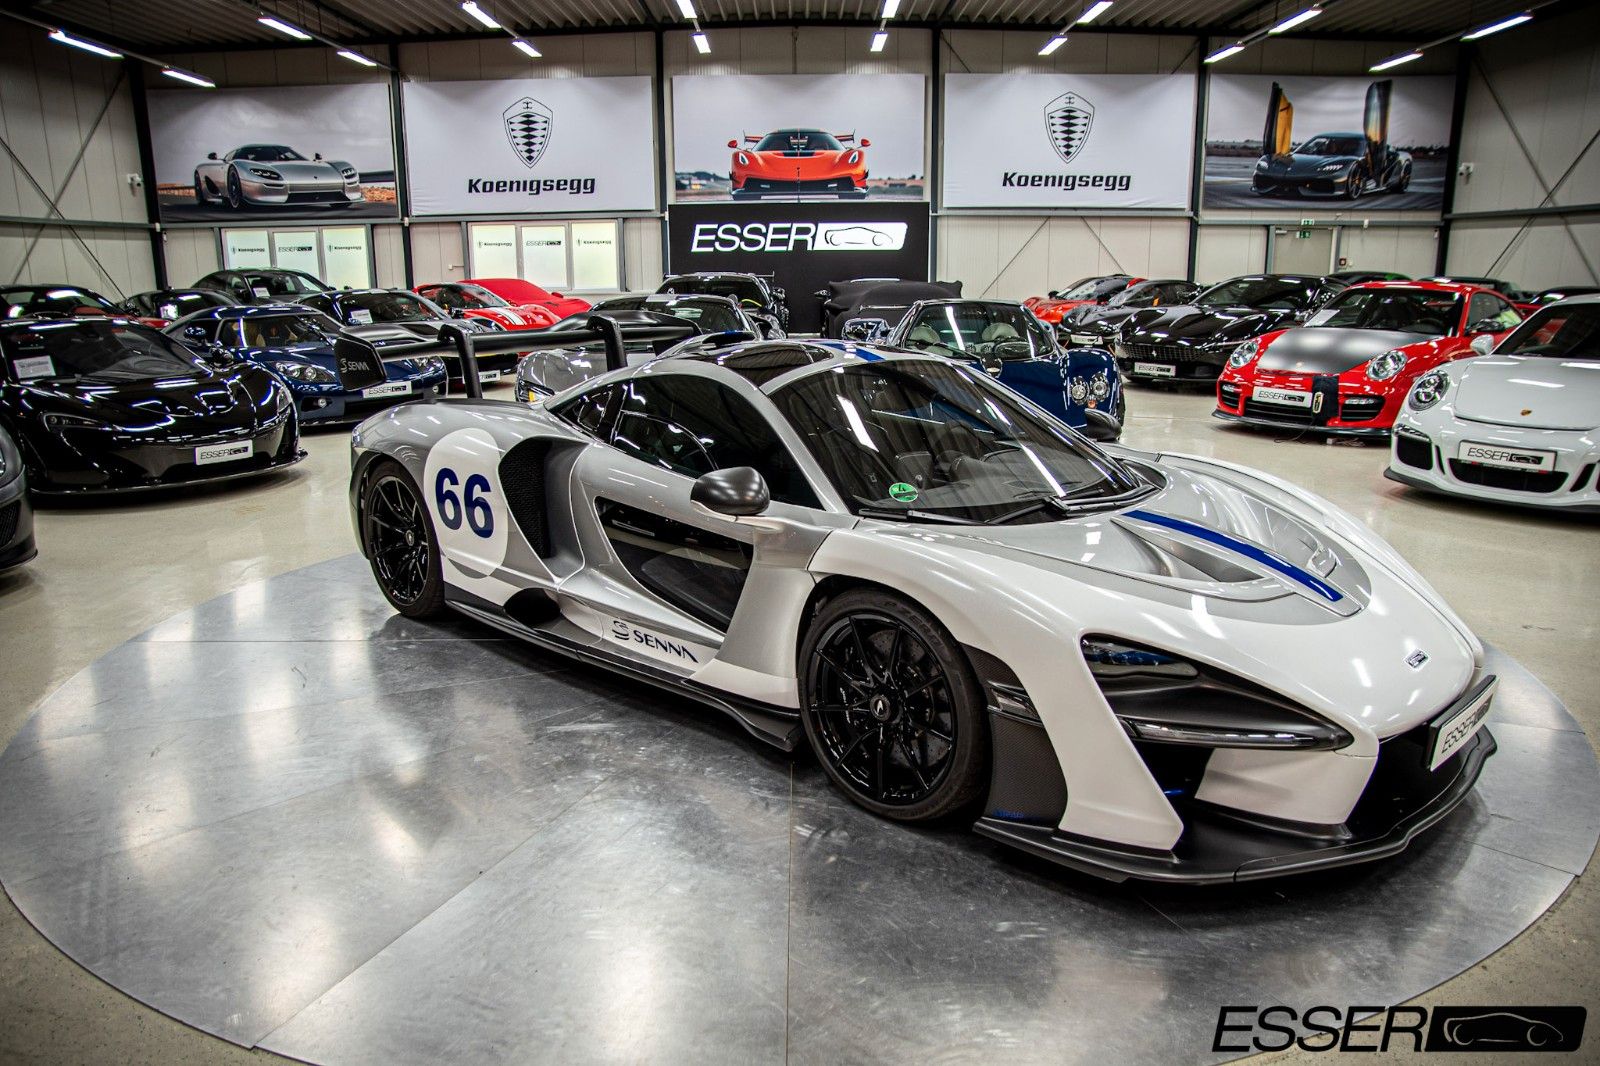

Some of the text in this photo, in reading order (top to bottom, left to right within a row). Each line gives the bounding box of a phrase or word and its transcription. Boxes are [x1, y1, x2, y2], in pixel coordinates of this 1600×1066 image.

[468, 178, 596, 195] Koenigsegg
[1002, 172, 1131, 191] Koenigsegg
[691, 223, 816, 252] ESSER
[1258, 390, 1285, 401] ESSER
[200, 449, 231, 460] ESSER
[1467, 447, 1510, 462] ESSER
[435, 467, 494, 538] 66
[632, 629, 699, 664] SENNA
